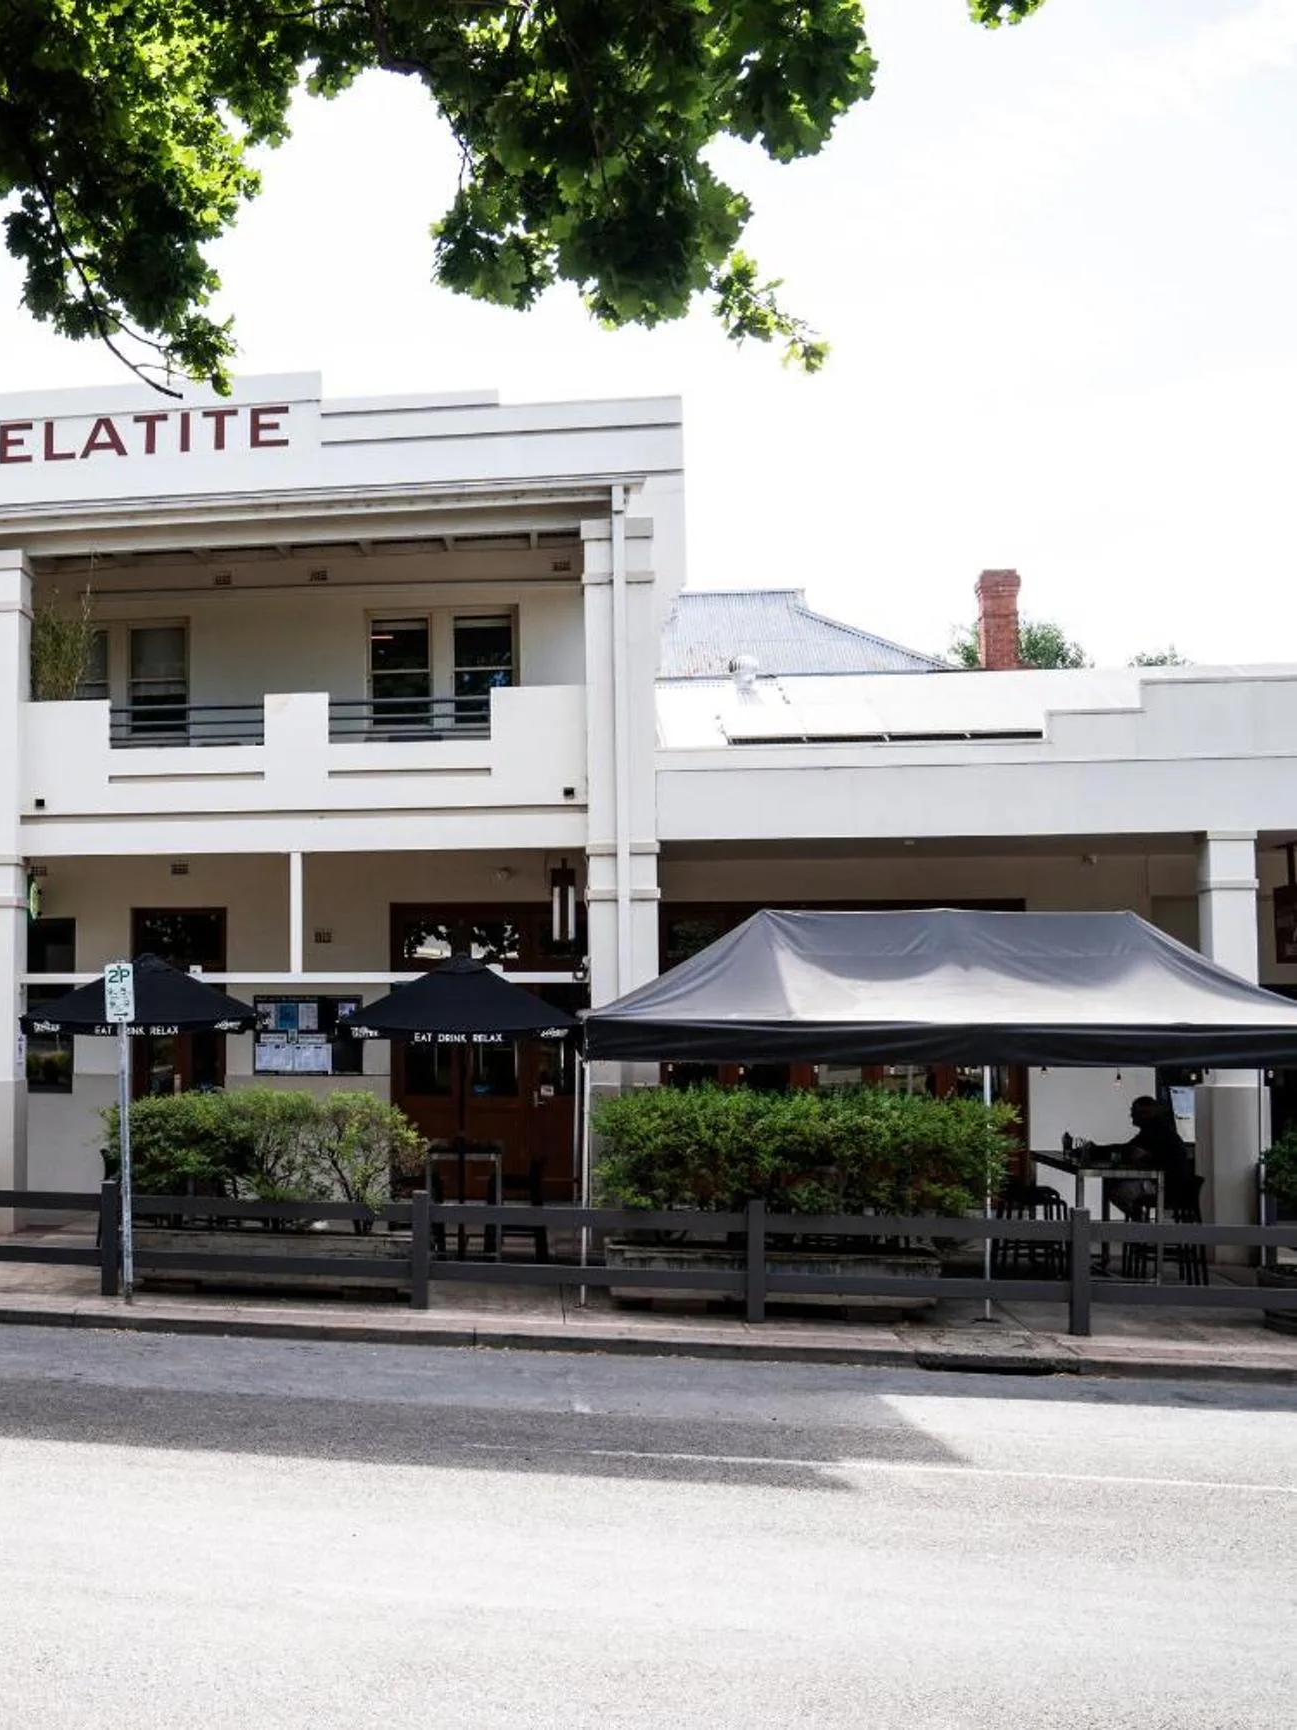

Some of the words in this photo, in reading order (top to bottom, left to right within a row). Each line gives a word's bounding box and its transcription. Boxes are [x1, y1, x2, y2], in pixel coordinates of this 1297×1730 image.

[108, 968, 131, 984] 2P
[94, 1025, 113, 1036] EAT
[150, 1025, 179, 1036] RELAX
[413, 1032, 433, 1043] EAT
[437, 1033, 468, 1043] DRINK
[472, 1033, 503, 1043] RELAX
